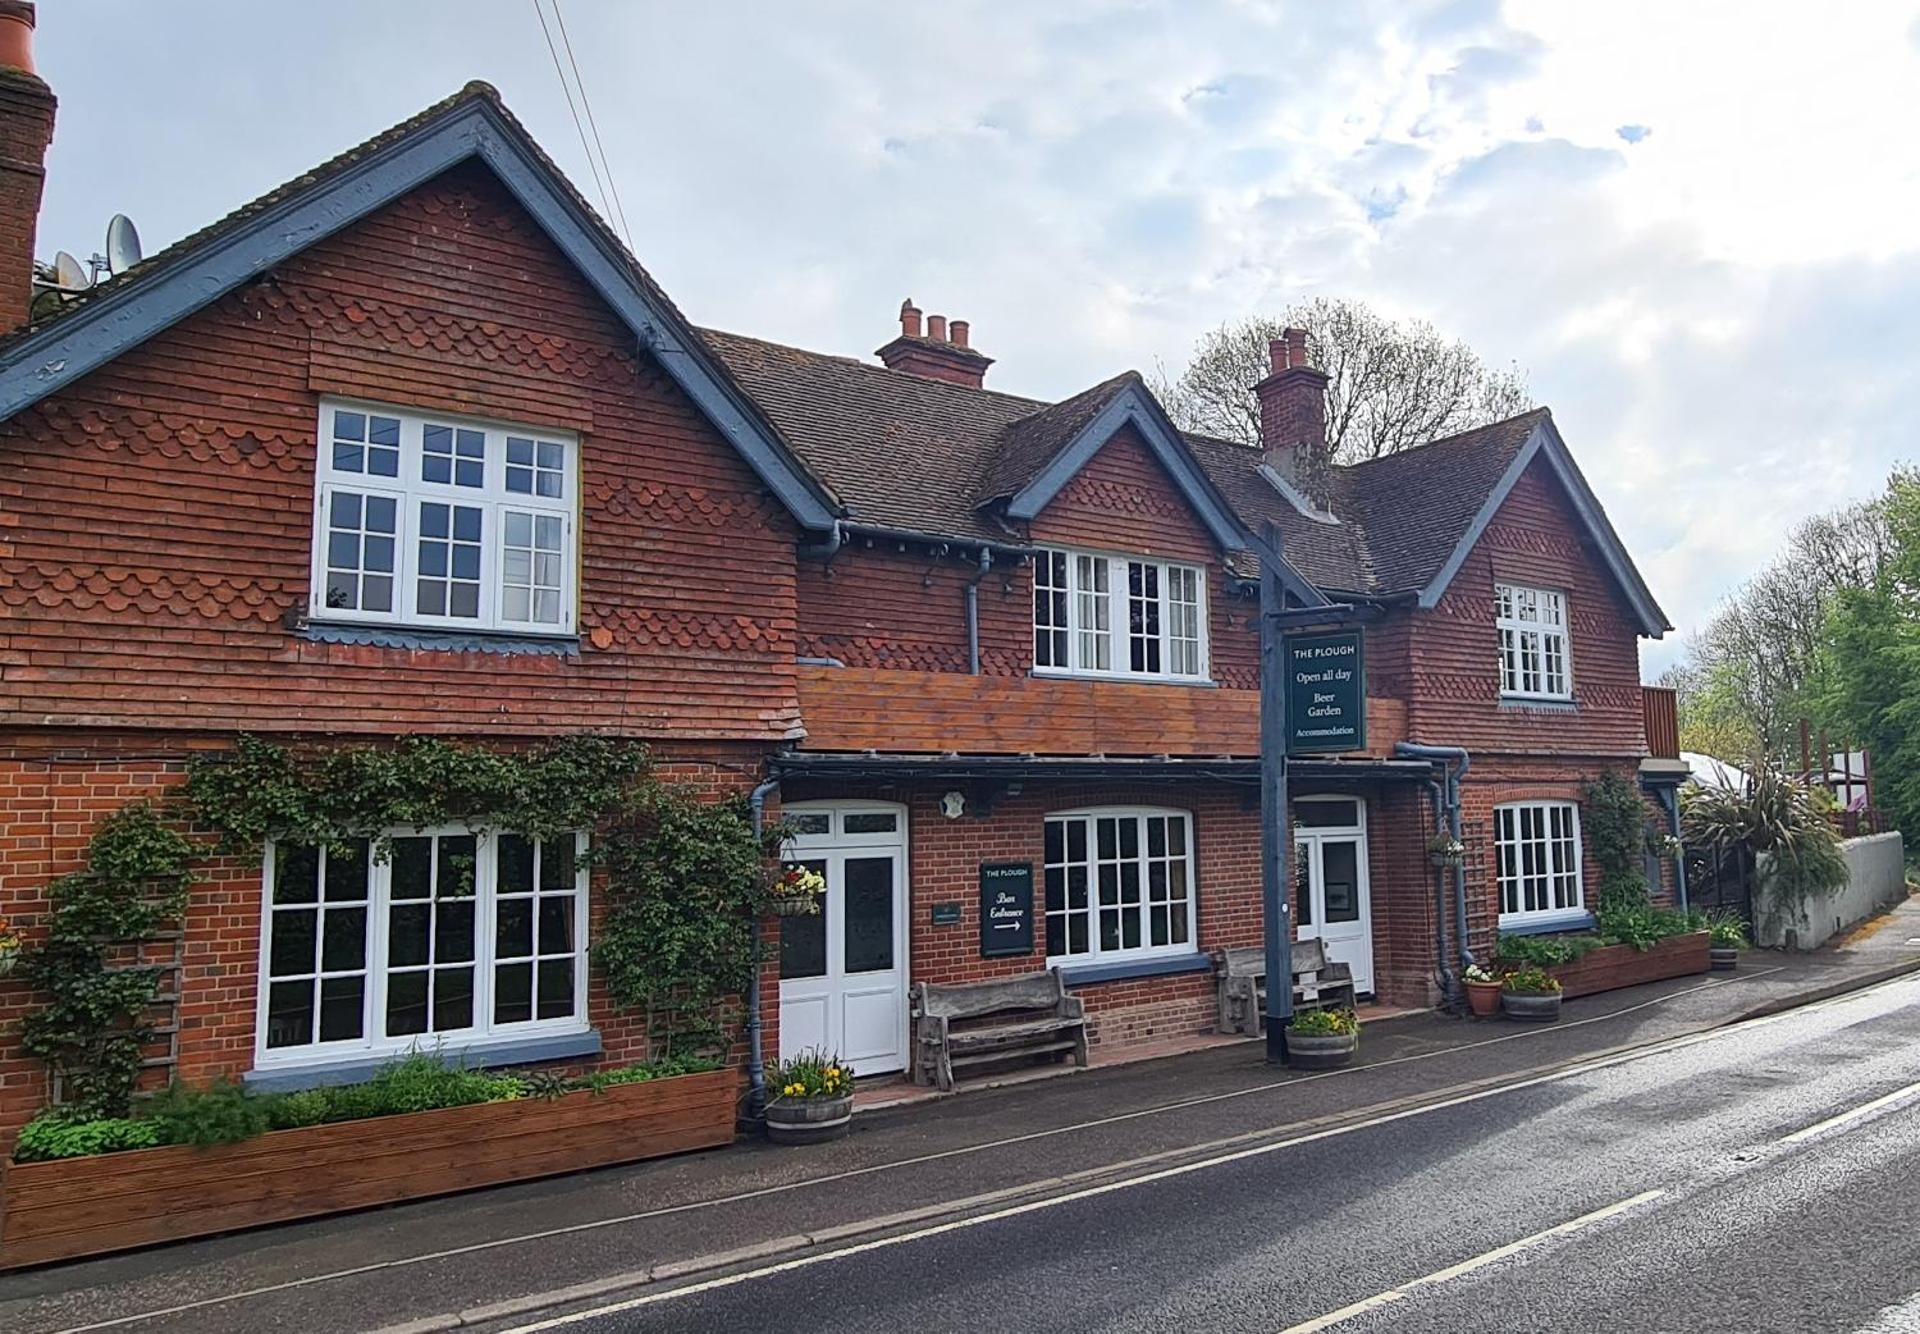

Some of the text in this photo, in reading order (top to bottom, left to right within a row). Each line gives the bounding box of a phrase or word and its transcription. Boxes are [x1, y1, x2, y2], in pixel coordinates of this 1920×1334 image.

[1294, 646, 1355, 659] THE PLOUGH
[1296, 669, 1352, 684] Open all day
[1314, 693, 1335, 703] Beer
[1308, 705, 1341, 716] Garden
[1296, 726, 1353, 736] Accommodation
[996, 892, 1015, 904] Bar
[990, 907, 1023, 918] Entrance
